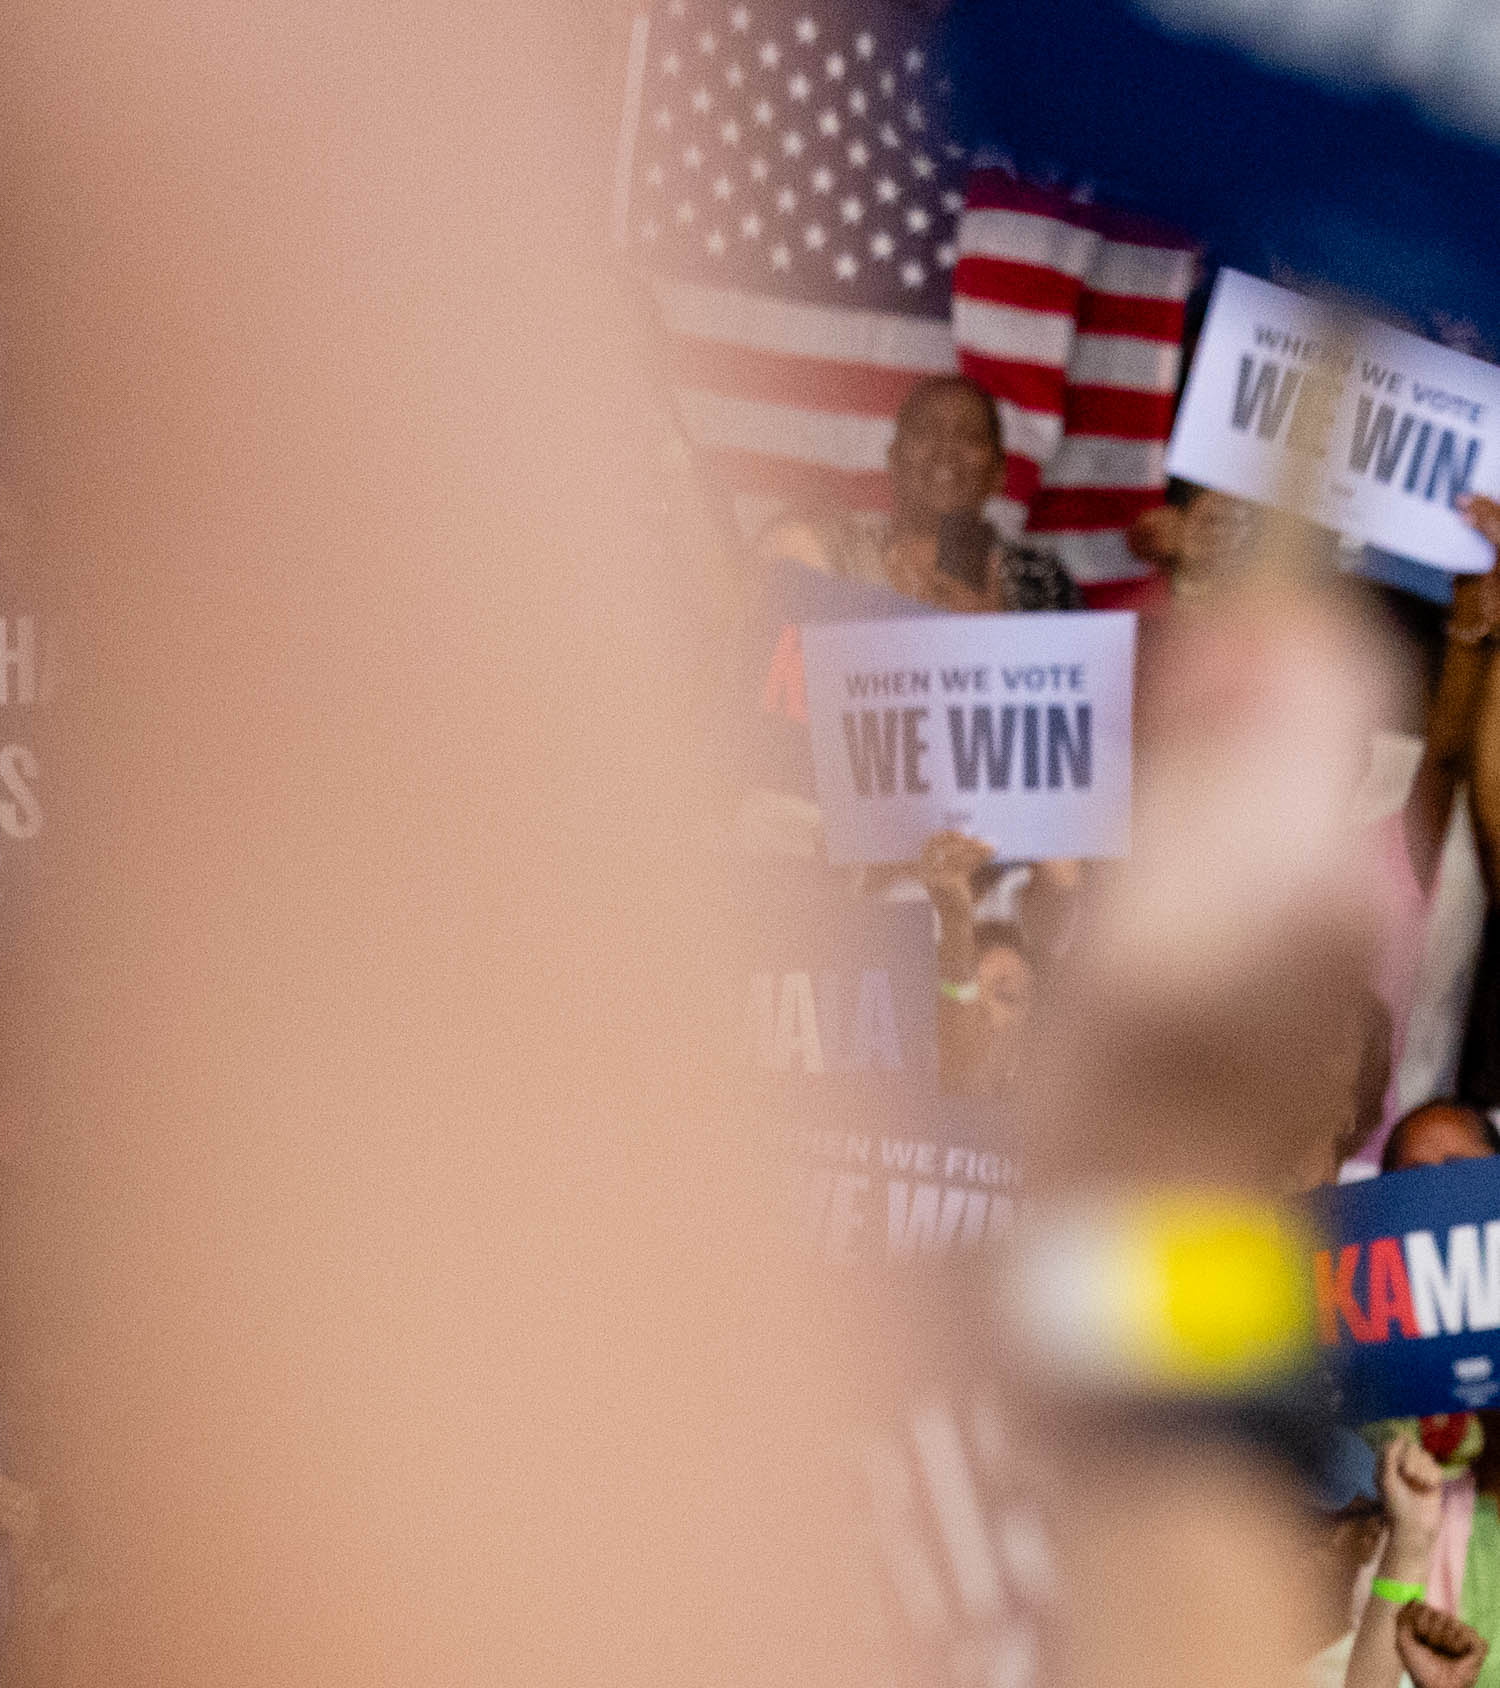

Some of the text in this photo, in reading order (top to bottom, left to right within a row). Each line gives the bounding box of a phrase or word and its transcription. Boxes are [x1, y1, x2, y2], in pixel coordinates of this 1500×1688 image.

[1349, 394, 1480, 510] WIN
[941, 666, 989, 694] WE
[1001, 663, 1085, 693] VOTE
[842, 703, 1094, 797] WE WIN
[1313, 1219, 1500, 1346] KAM
